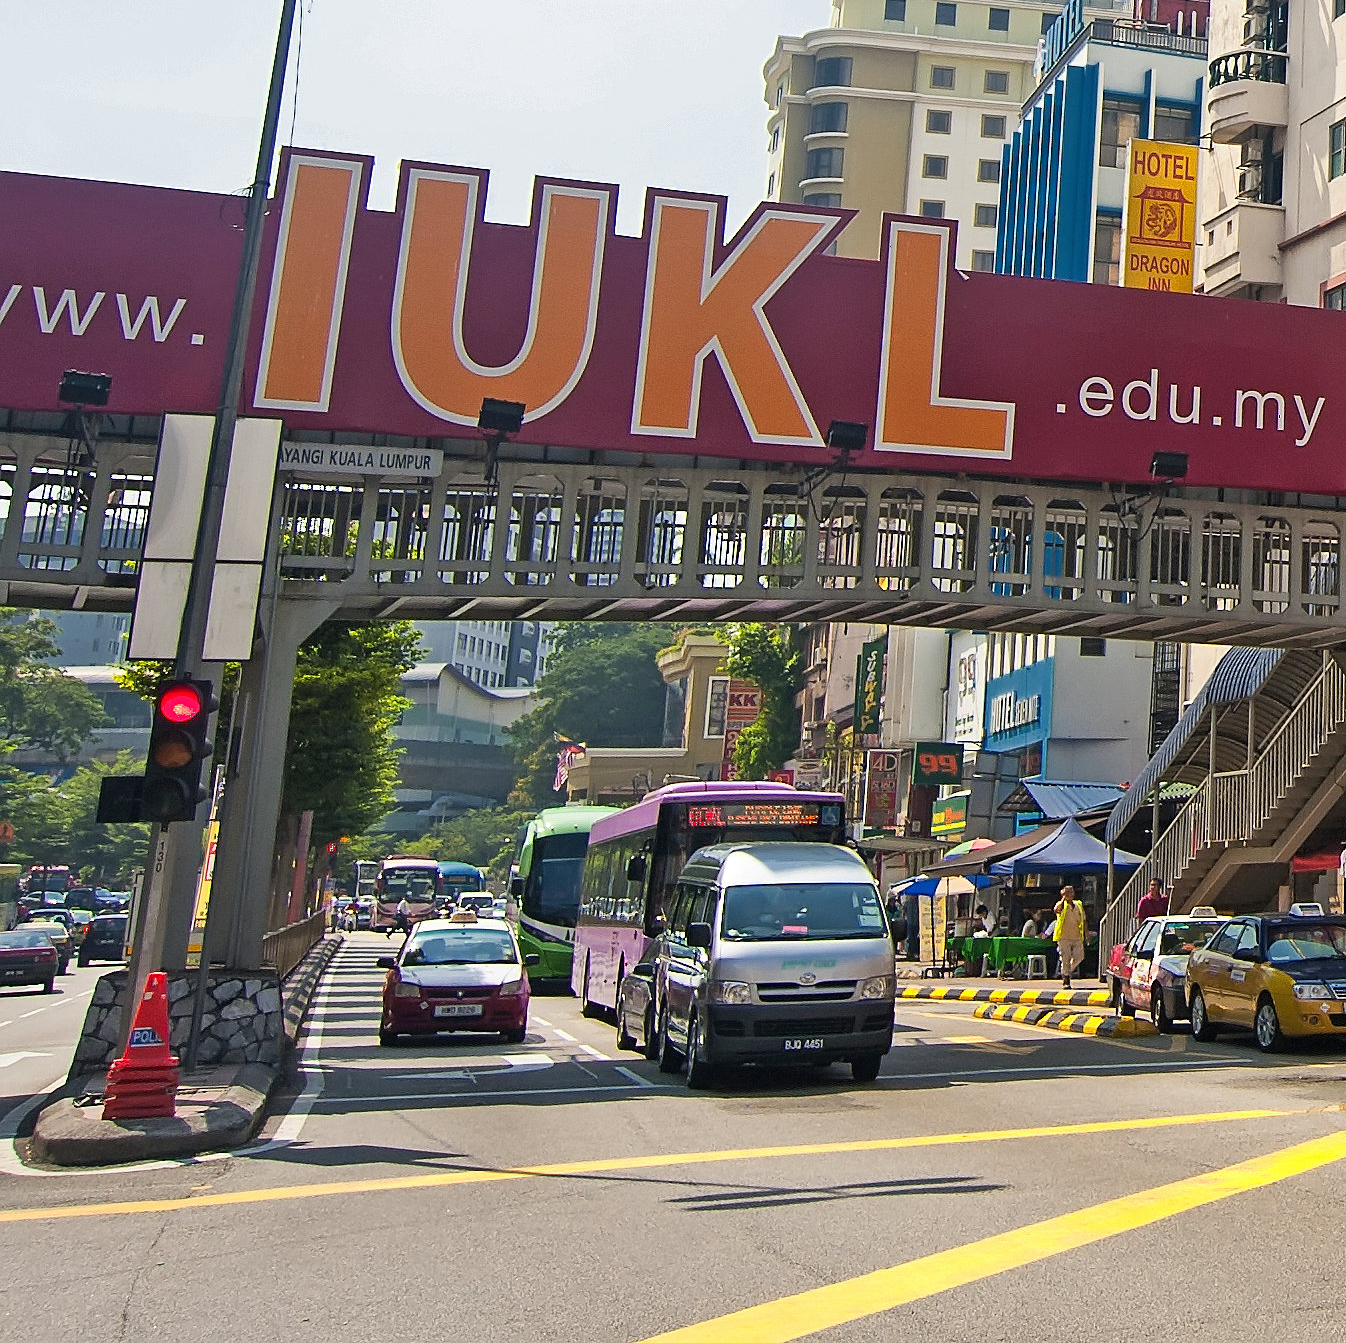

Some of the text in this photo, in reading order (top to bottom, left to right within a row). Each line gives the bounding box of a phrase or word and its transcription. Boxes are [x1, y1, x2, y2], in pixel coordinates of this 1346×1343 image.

[1134, 150, 1195, 181] HOTEL
[1130, 253, 1190, 276] DRAGON
[1148, 277, 1171, 291] INN
[253, 153, 1016, 461] IUKL
[1055, 368, 1326, 447] .edu.my
[329, 450, 374, 468] KUALA
[379, 453, 432, 470] LUMPUR
[730, 693, 758, 707] KK
[860, 650, 879, 733] SUBWAY
[872, 755, 898, 773] 4D
[918, 753, 959, 775] 99
[156, 841, 165, 872] 130
[784, 1038, 824, 1050] BJQ 4451
